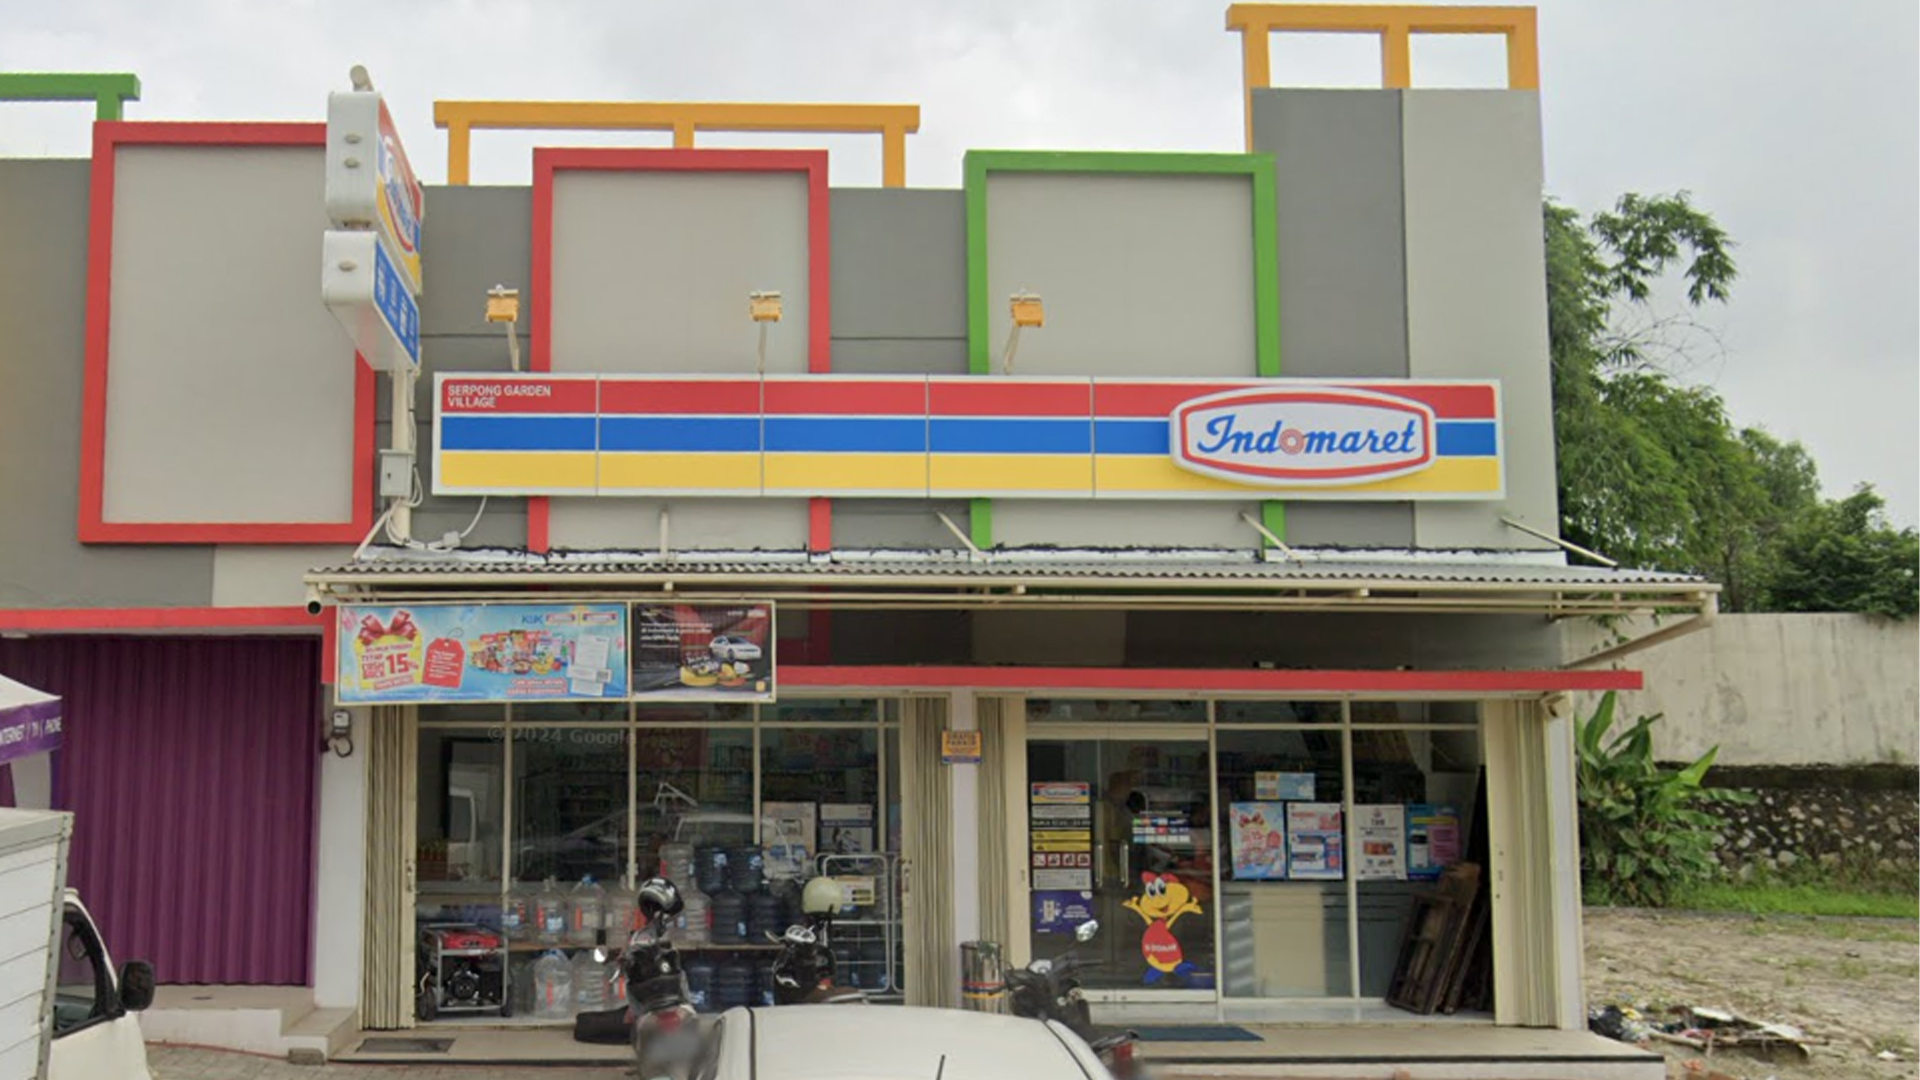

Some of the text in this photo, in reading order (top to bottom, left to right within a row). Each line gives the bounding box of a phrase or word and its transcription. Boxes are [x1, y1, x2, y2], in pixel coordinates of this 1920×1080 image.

[448, 385, 551, 397] SERPONG GARDEN
[448, 397, 496, 408] VILLAGE
[1197, 414, 1417, 456] Indomaret
